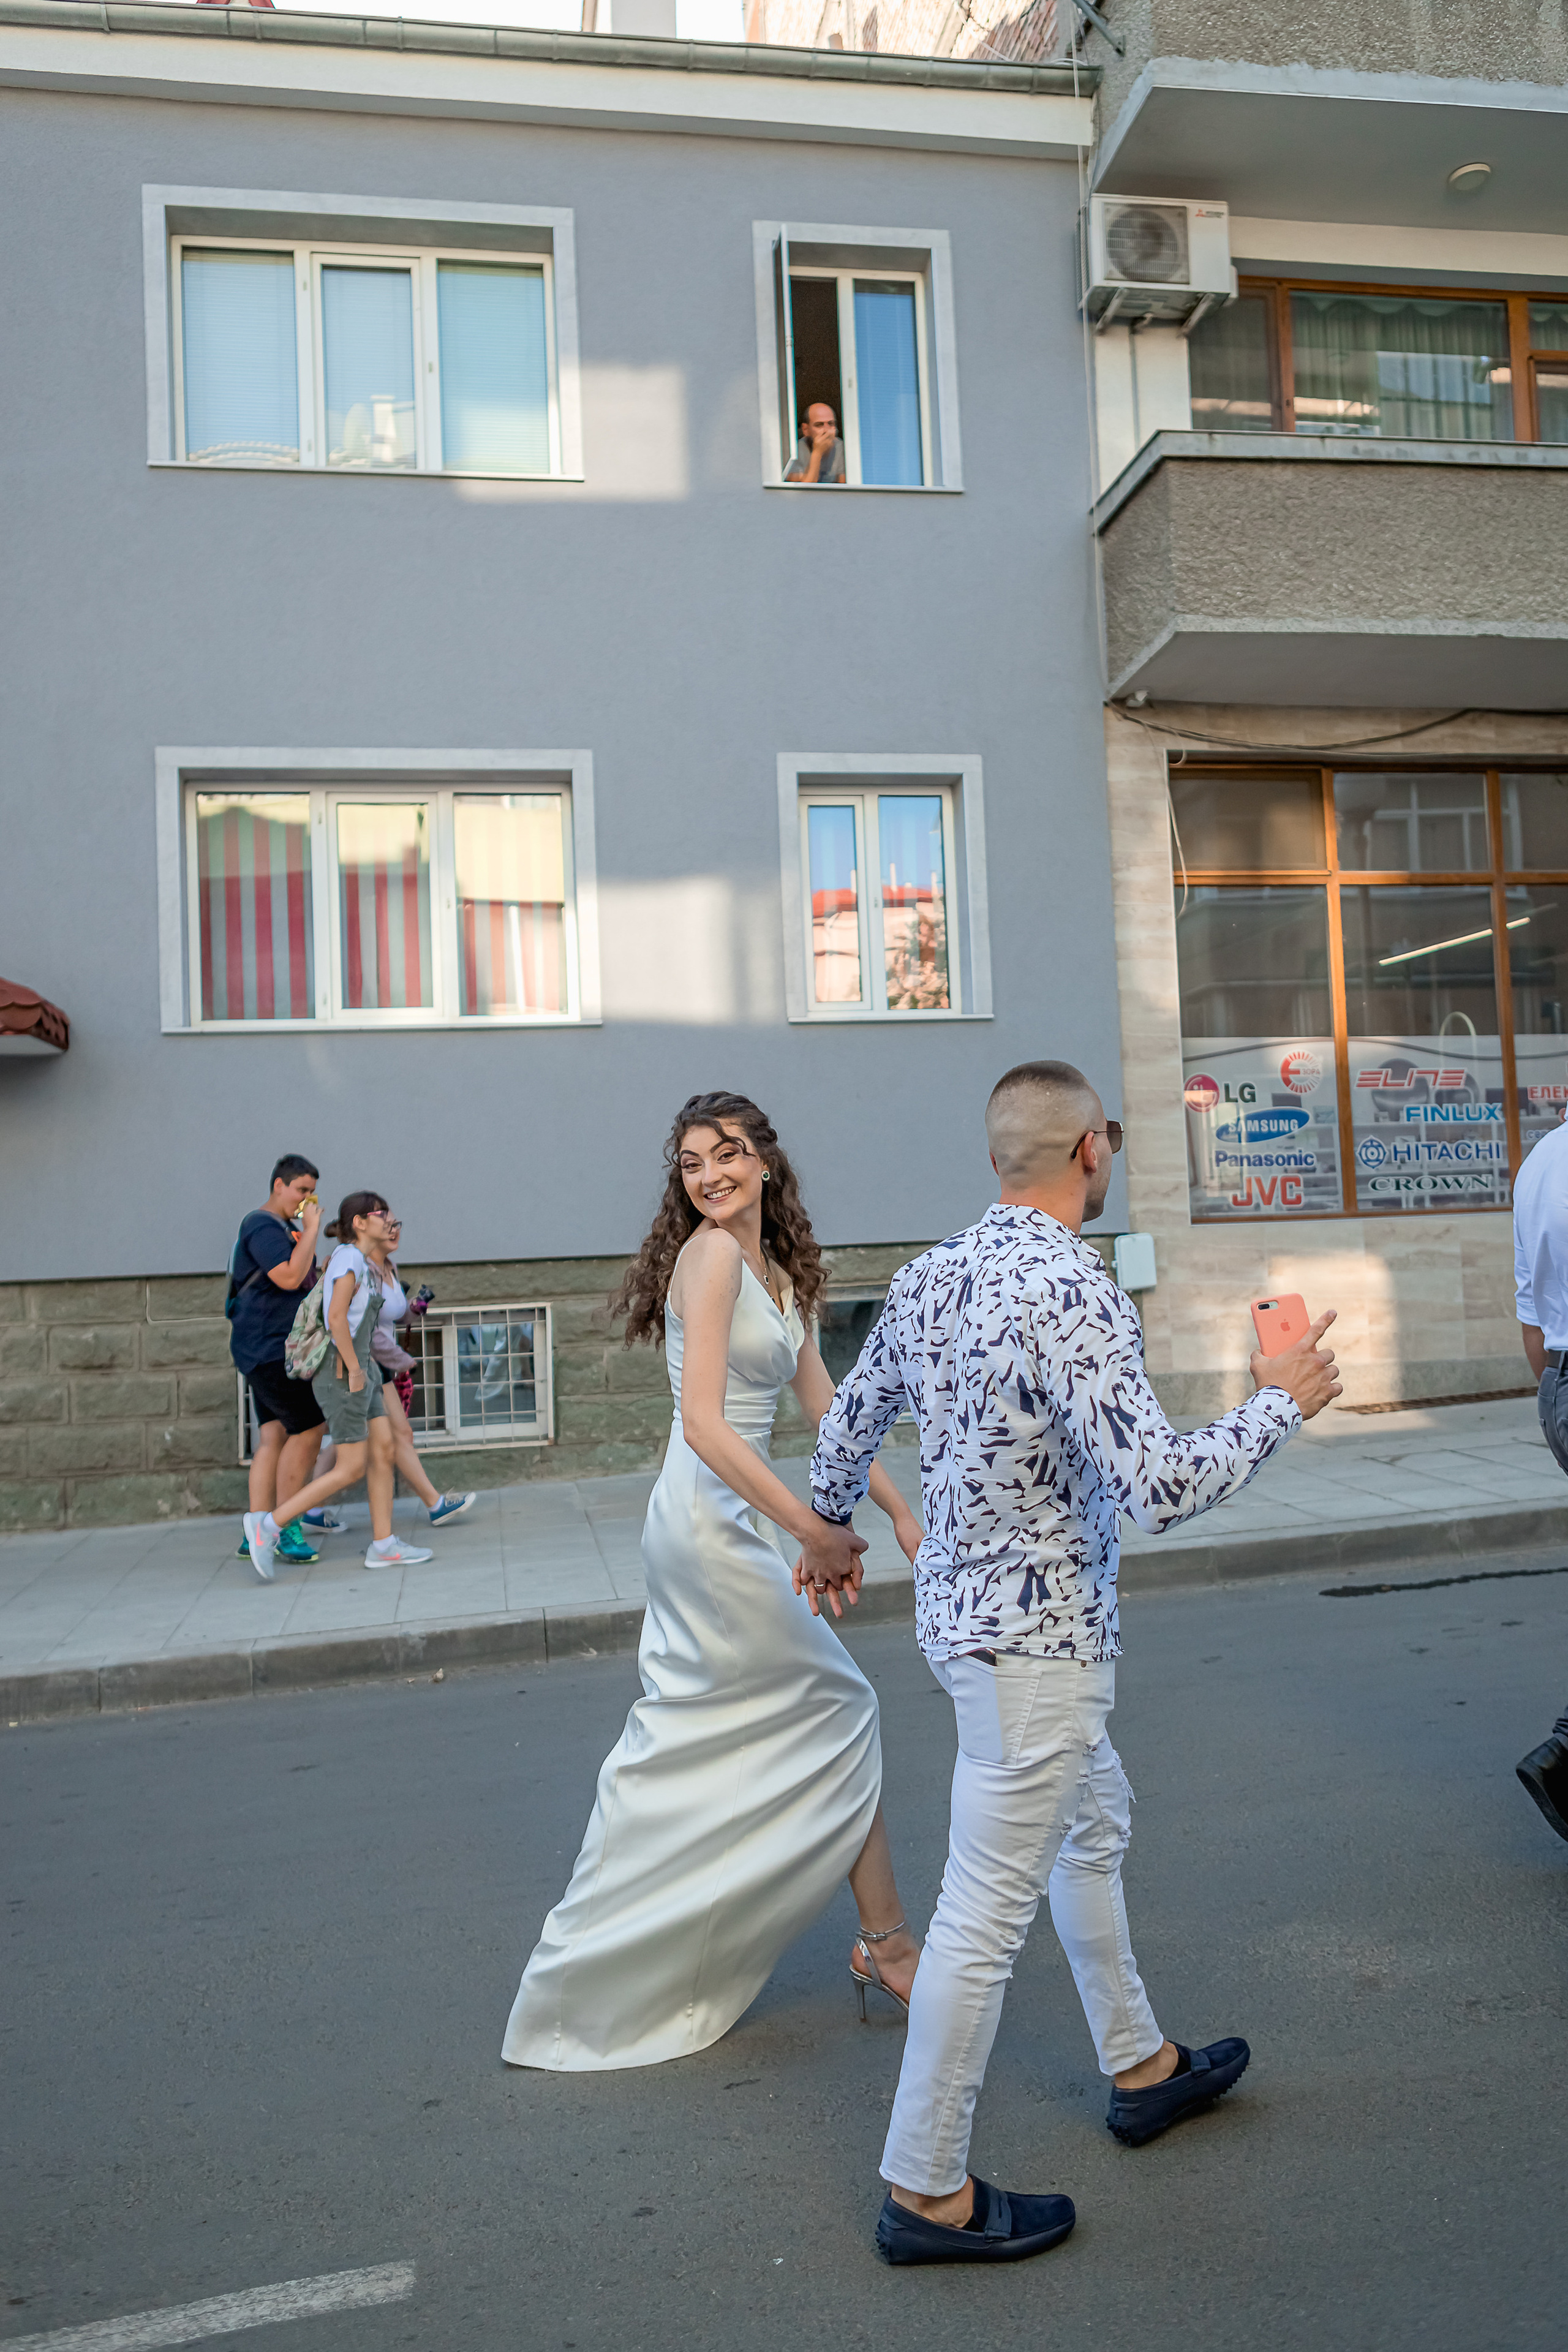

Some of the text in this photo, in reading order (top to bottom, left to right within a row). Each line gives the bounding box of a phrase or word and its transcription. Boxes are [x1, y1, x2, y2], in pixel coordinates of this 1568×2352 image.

[1224, 1082, 1256, 1102] LG
[1406, 1104, 1500, 1121] FINLUX
[1228, 1119, 1298, 1132] SAMSUNG
[1215, 1149, 1314, 1167] Panasonic
[1393, 1143, 1501, 1161] HITACHI
[1232, 1176, 1302, 1206] JVC
[1370, 1174, 1493, 1191] CROWN
